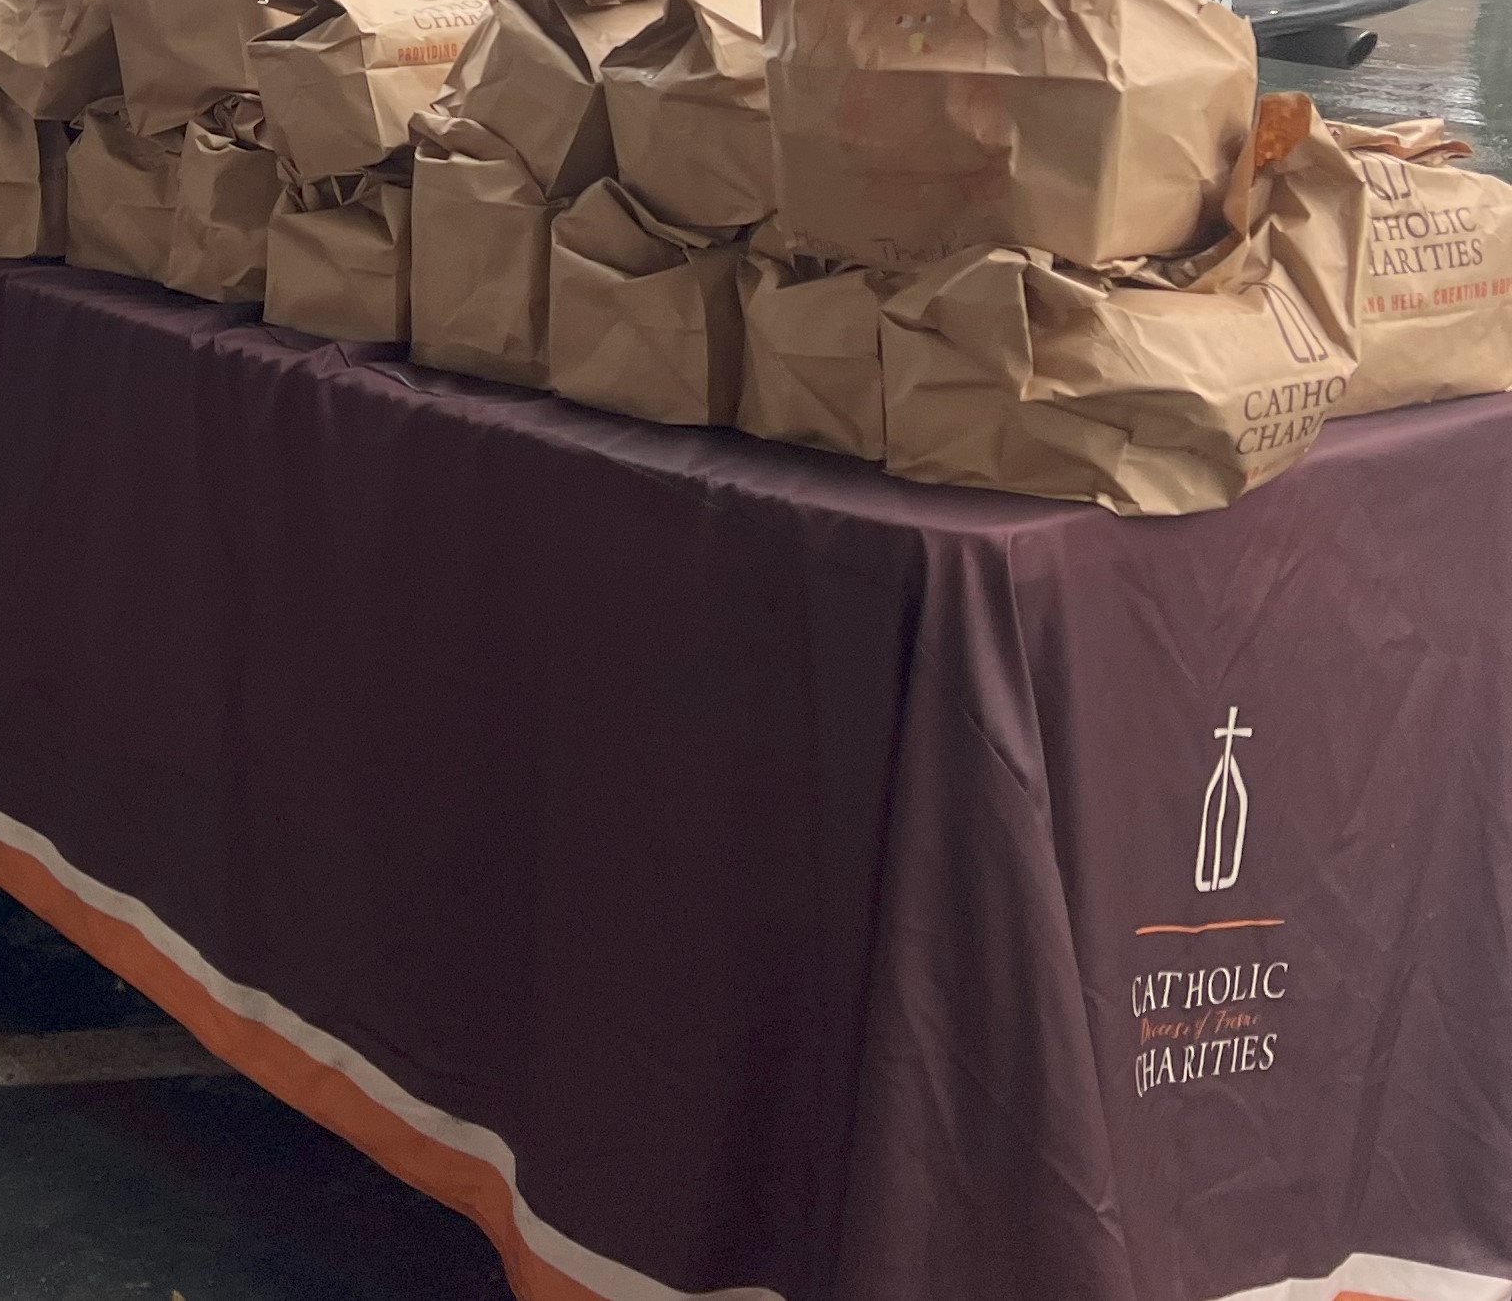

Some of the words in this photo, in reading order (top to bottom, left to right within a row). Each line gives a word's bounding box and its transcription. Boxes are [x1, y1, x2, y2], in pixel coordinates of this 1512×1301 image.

[398, 43, 458, 61] PROVIDING
[1433, 282, 1487, 306] CREATING
[1132, 962, 1288, 1018] CATHOLIC
[1135, 1033, 1277, 1097] CHARITIES
